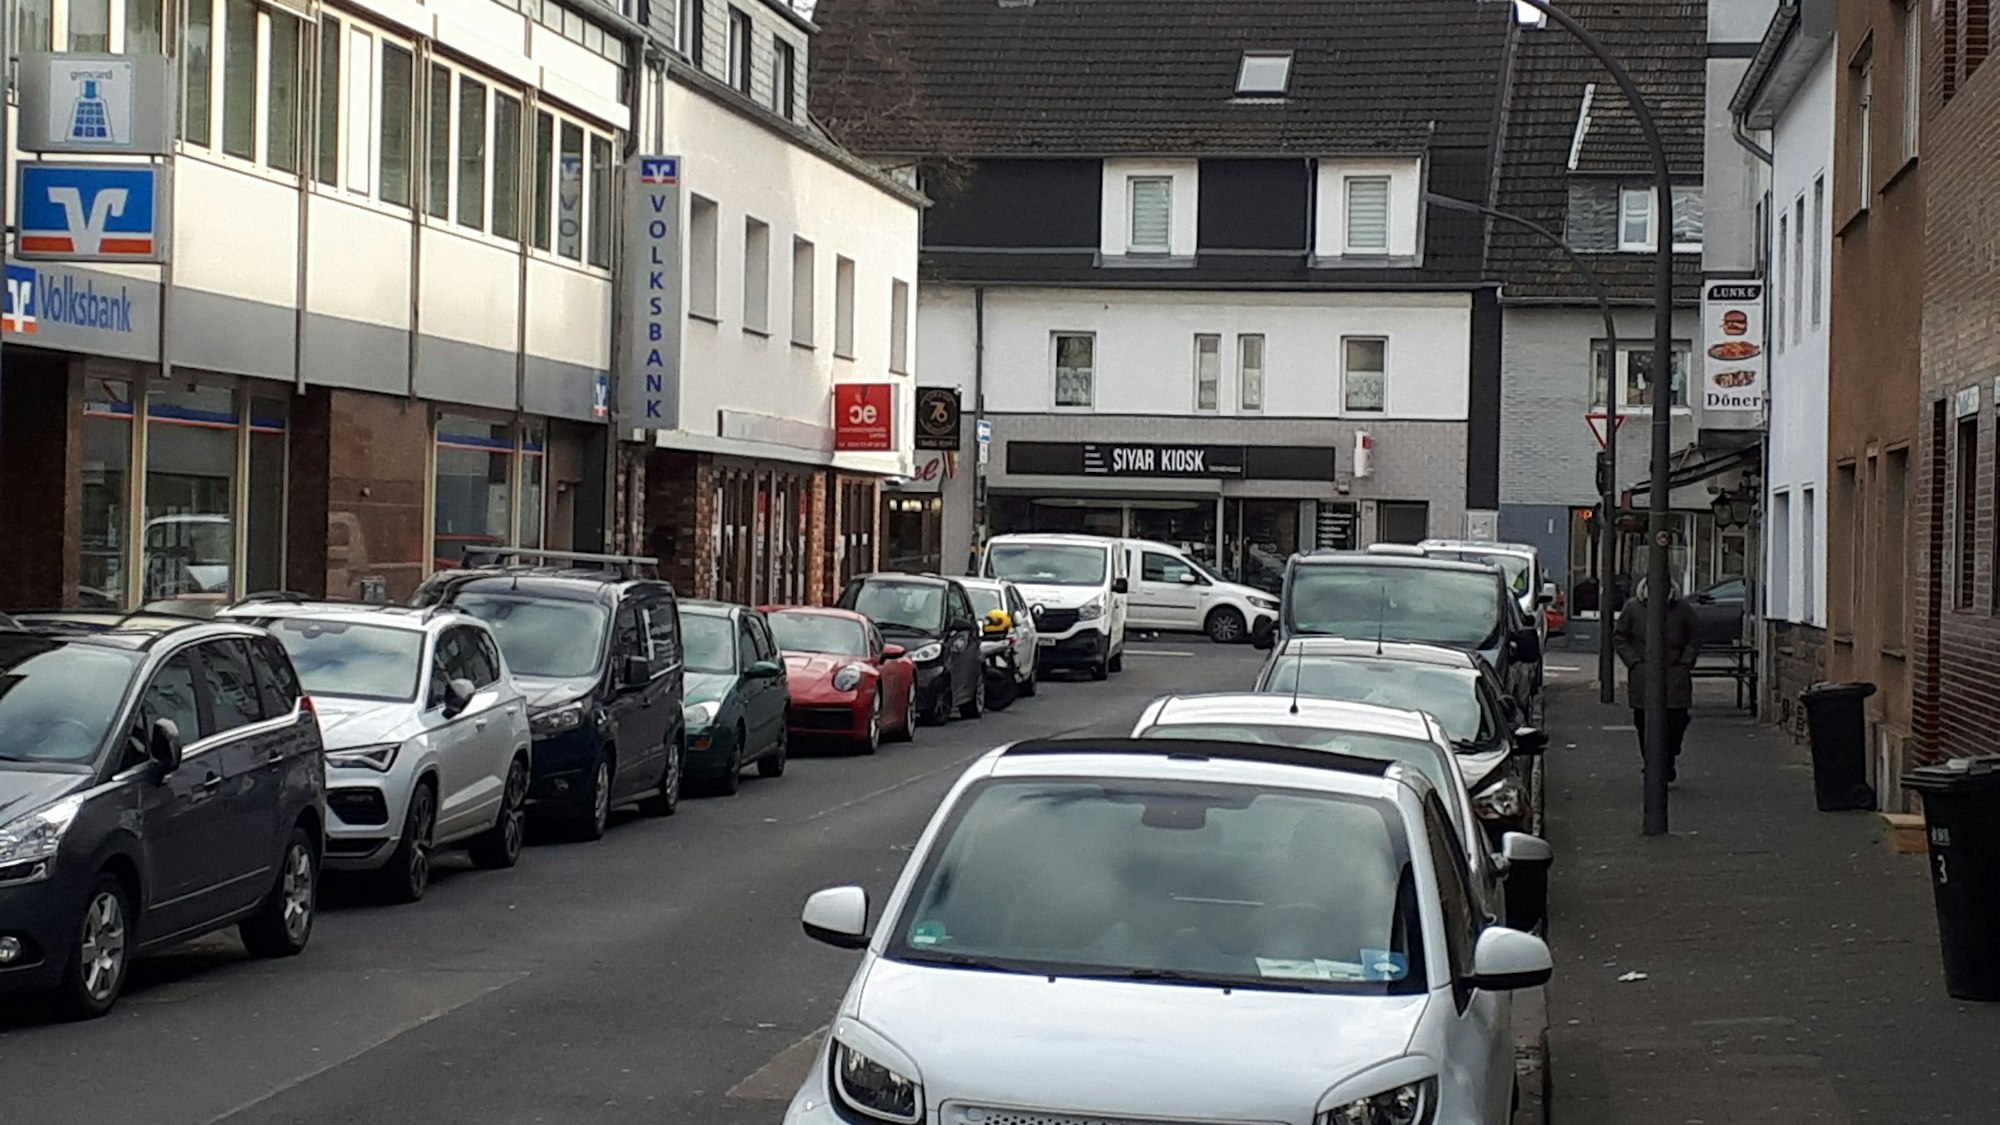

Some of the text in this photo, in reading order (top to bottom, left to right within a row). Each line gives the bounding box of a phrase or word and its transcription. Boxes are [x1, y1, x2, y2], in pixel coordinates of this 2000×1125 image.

[40, 273, 132, 333] Volksbank
[646, 194, 667, 419] VOLKSBANK
[1707, 393, 1761, 407] Döner
[1161, 449, 1205, 472] KIOSK
